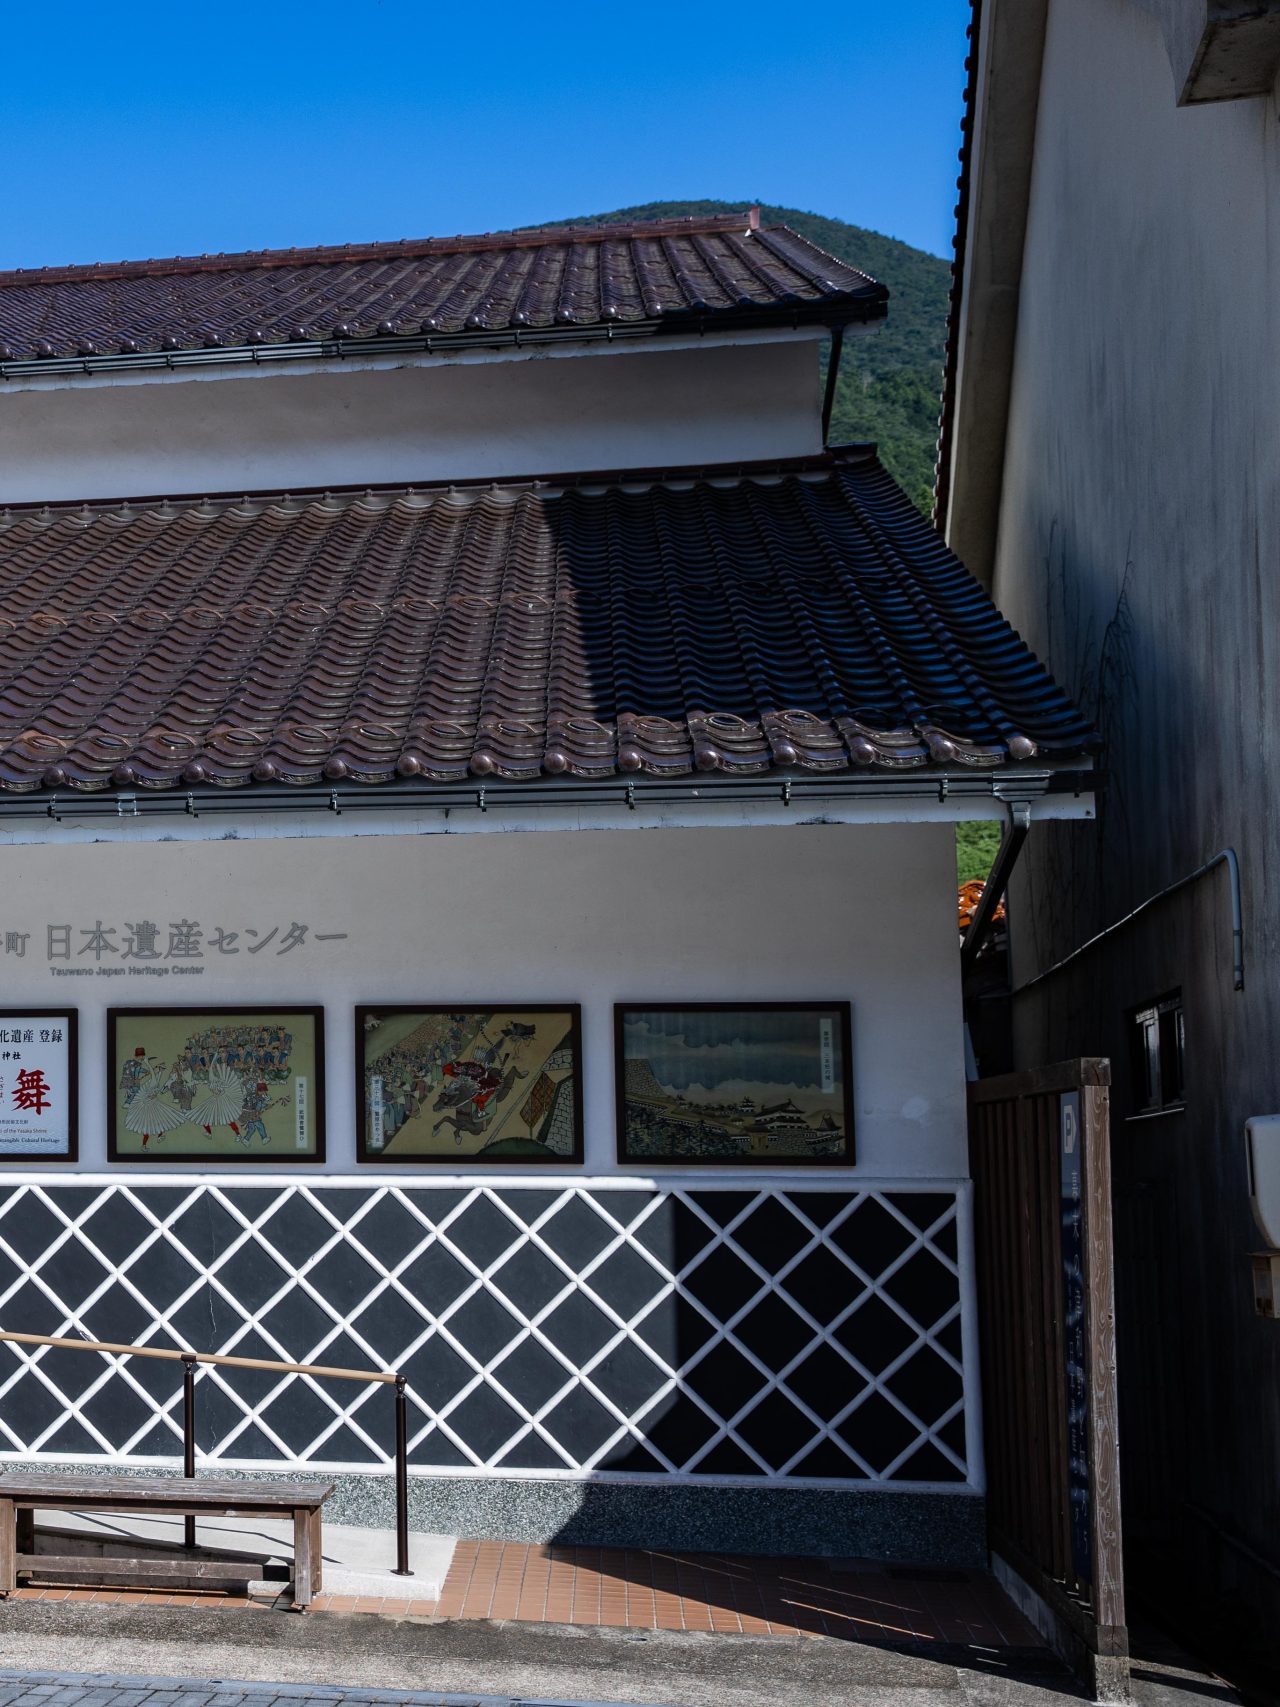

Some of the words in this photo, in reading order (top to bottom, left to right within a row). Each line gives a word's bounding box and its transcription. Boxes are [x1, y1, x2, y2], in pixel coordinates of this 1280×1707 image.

[47, 918, 348, 960] 日本遺産センター
[50, 966, 94, 977] Tsuwano
[96, 966, 126, 977] Japan
[128, 965, 170, 977] Heritage
[172, 965, 205, 976] Center
[38, 1028, 63, 1043] 登録
